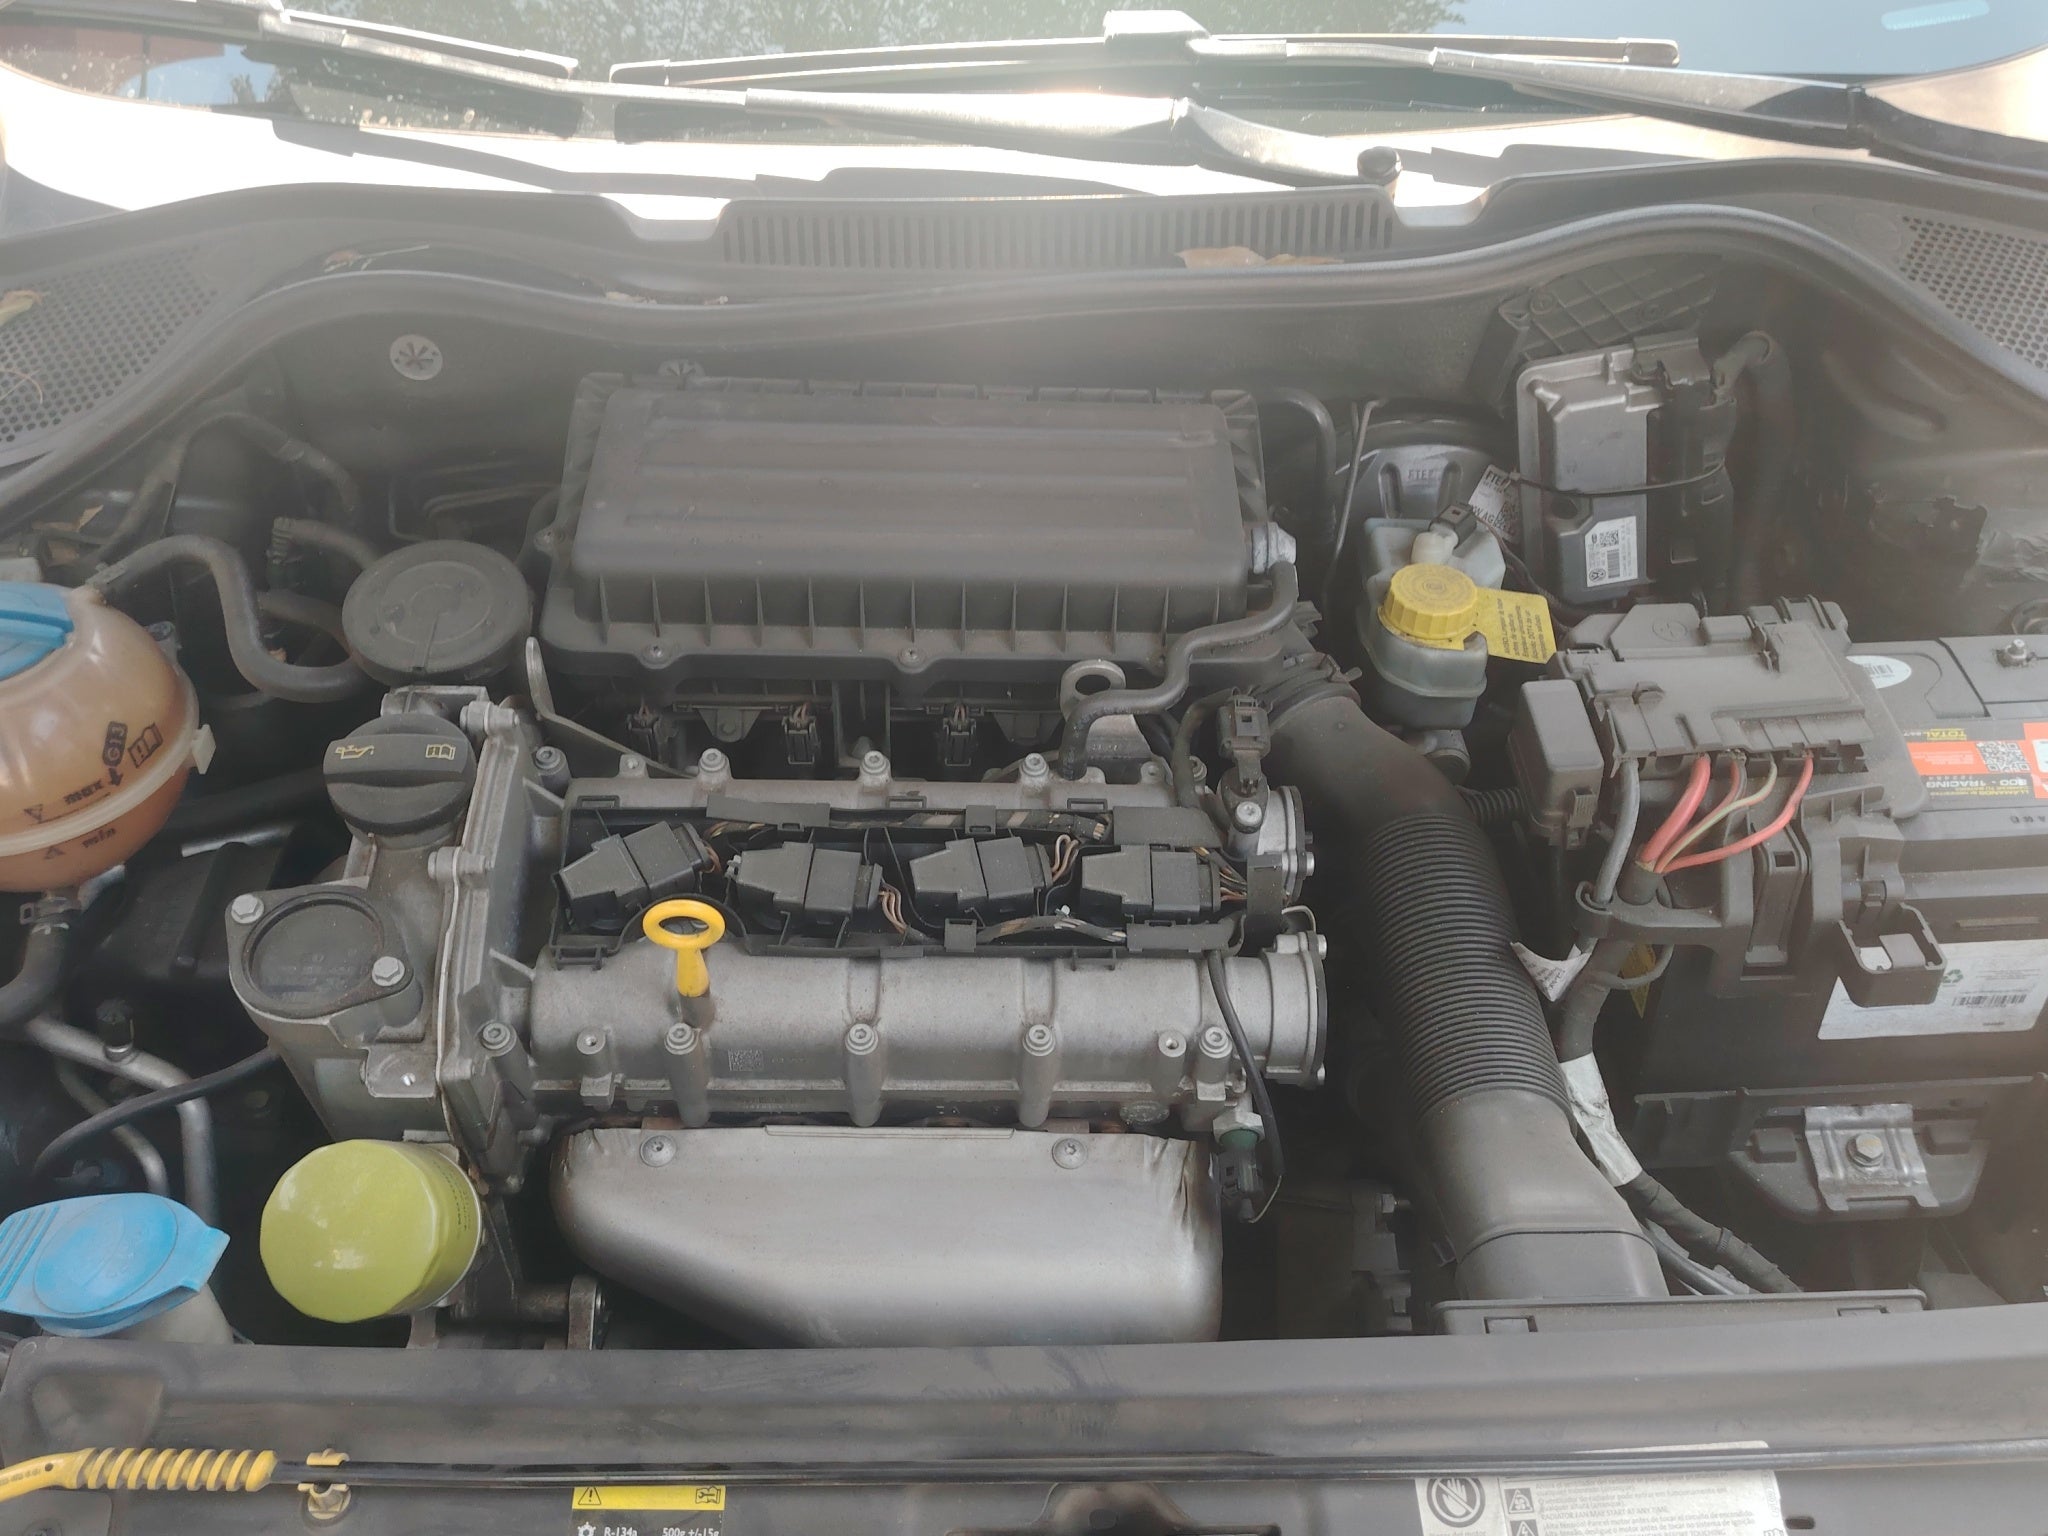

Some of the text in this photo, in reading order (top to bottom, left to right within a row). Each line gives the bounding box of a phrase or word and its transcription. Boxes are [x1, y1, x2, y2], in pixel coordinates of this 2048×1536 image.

[1925, 730, 1967, 739] TOTAL
[63, 779, 104, 804] max
[82, 828, 116, 848] min
[604, 1527, 638, 1536] R-134a
[663, 1527, 686, 1536] 500g
